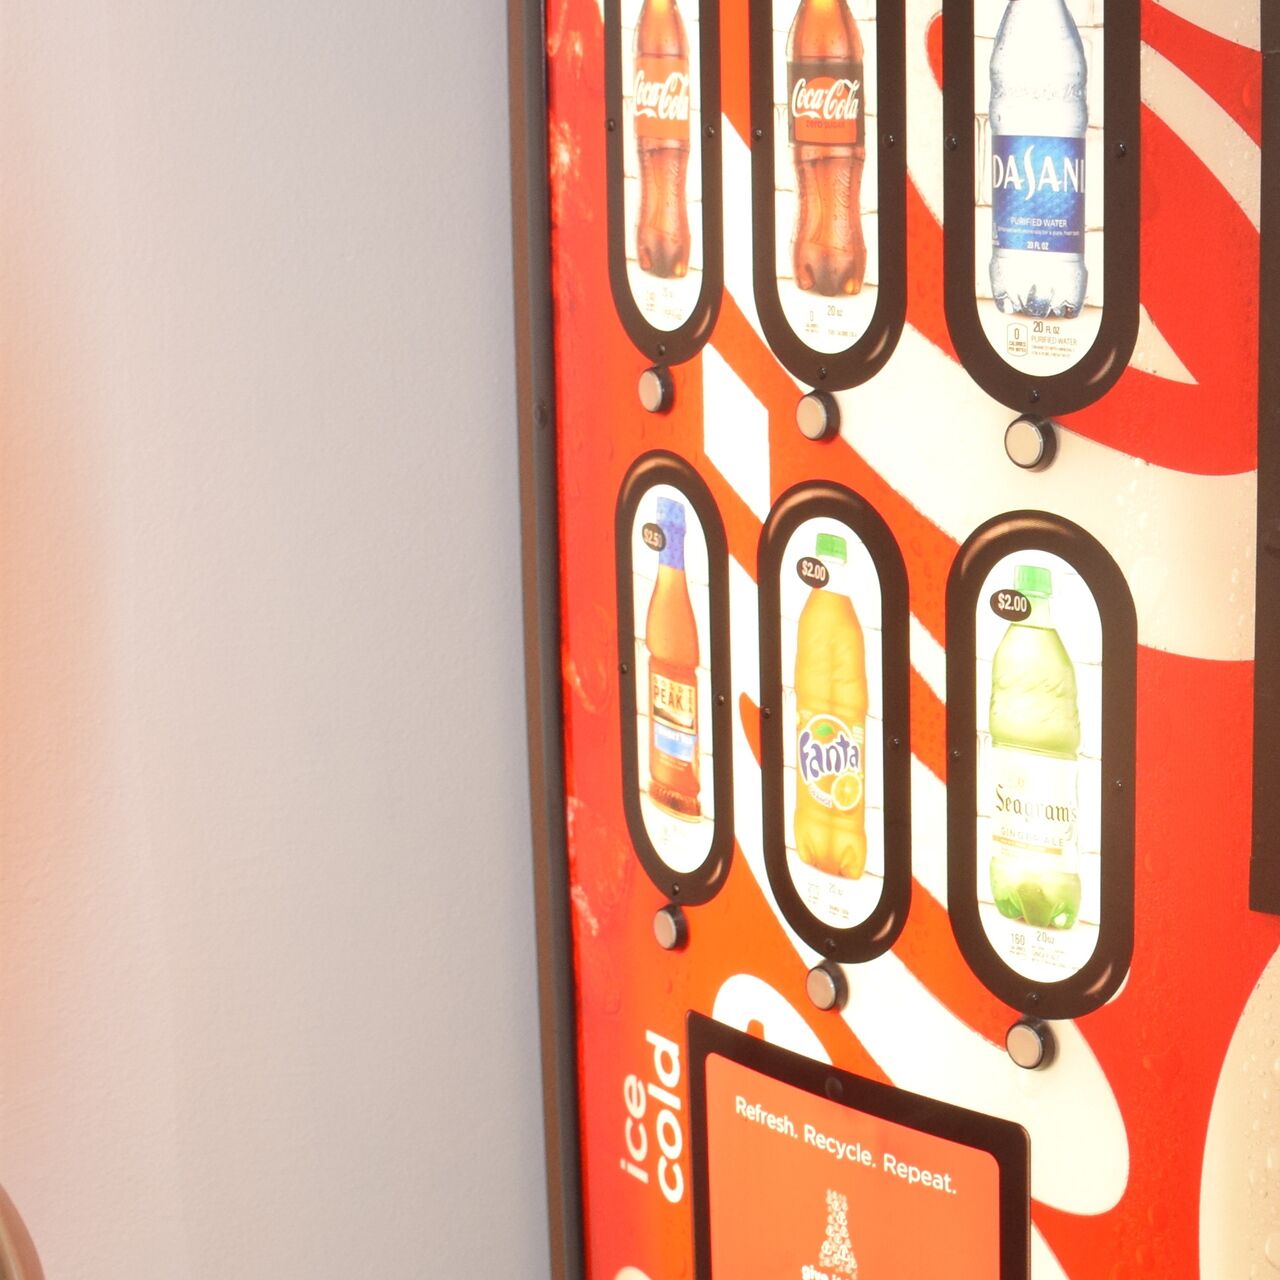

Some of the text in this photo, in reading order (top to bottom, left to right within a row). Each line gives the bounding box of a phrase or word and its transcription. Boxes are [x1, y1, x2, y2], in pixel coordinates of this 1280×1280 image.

[634, 69, 690, 121] Coca-Cola
[791, 77, 860, 121] Coca-Cola
[992, 144, 1085, 201] DASANI
[1010, 216, 1068, 228] PURIFIED WATER
[1014, 328, 1020, 340] 0
[1033, 321, 1043, 333] 20
[801, 560, 826, 581] $2.00
[998, 592, 1028, 612] $2.00
[655, 685, 684, 712] PEAK
[620, 1074, 649, 1184] ice
[645, 1029, 684, 1203] cold
[735, 1095, 957, 1195] Refresh. Recycle. Repeat.
